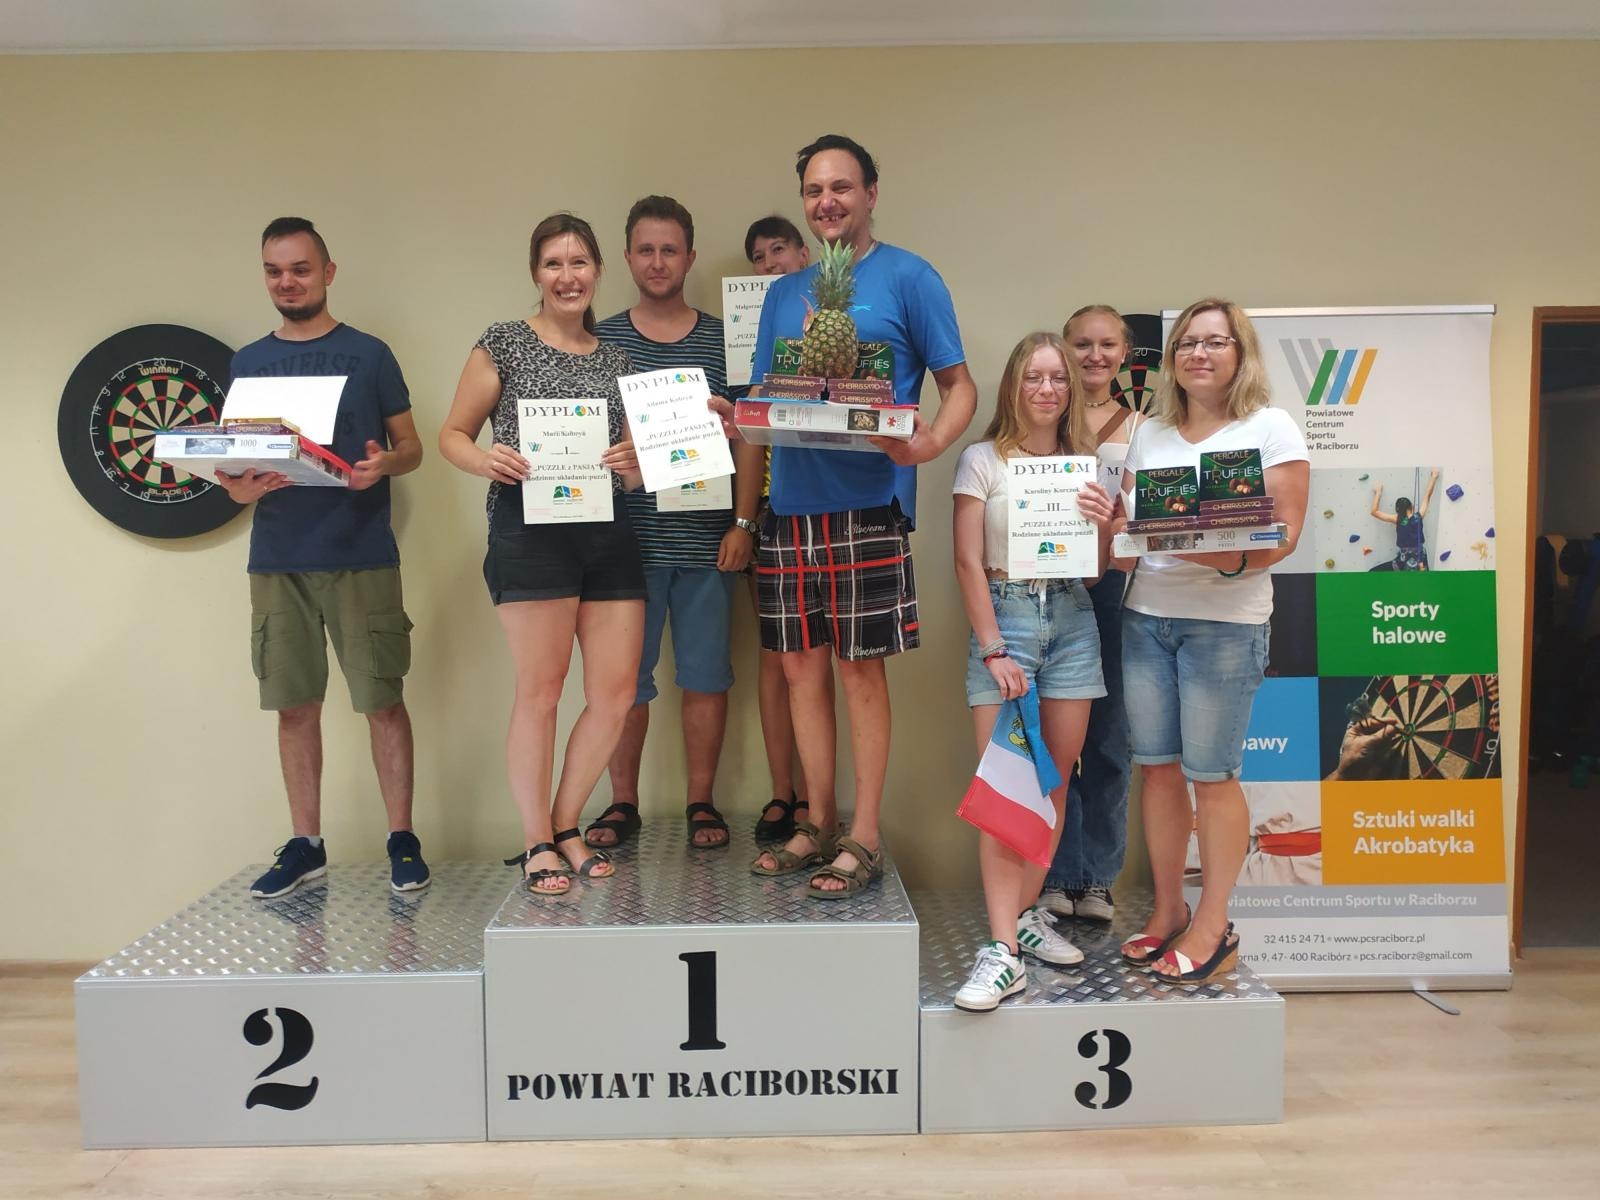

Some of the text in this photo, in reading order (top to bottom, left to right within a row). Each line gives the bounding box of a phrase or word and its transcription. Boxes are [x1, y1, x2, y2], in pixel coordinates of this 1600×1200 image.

[728, 282, 768, 292] DYPL
[856, 359, 890, 369] UFFLES
[524, 405, 601, 417] DYPLOM
[1306, 408, 1354, 418] Powiatowe
[1306, 420, 1344, 429] Centrum
[1306, 431, 1336, 441] Sportu
[1316, 441, 1359, 450] Raciborzu
[1213, 450, 1250, 460] PERGALE
[1014, 462, 1090, 475] DYPLOM
[1148, 468, 1185, 478] PERGALE
[1204, 466, 1262, 480] TRUFFLES
[1139, 483, 1197, 498] TRUFFLES
[1217, 530, 1236, 540] 500
[1371, 601, 1440, 622] Sporty
[1372, 626, 1446, 645] halowe
[1242, 736, 1288, 754] awy
[1353, 809, 1475, 829] Sztuki walki
[1353, 836, 1475, 857] Akrobatyka
[1283, 894, 1343, 907] Centrum
[1345, 894, 1391, 908] Sportu
[1394, 896, 1405, 906] w
[1409, 893, 1477, 906] Raciborzu
[1264, 933, 1425, 944] 32 415 24 71 www.pcsraciborz.pl
[1238, 953, 1259, 962] orna
[1289, 953, 1308, 961] 400
[1310, 952, 1352, 961] Racibórz
[1360, 951, 1472, 962] pcs.raciborz@gmail.com
[678, 951, 726, 1050] 1
[242, 1007, 319, 1110] 2
[1075, 1029, 1132, 1109] 3
[507, 1068, 899, 1101] POWIAT RACIBORSKI
